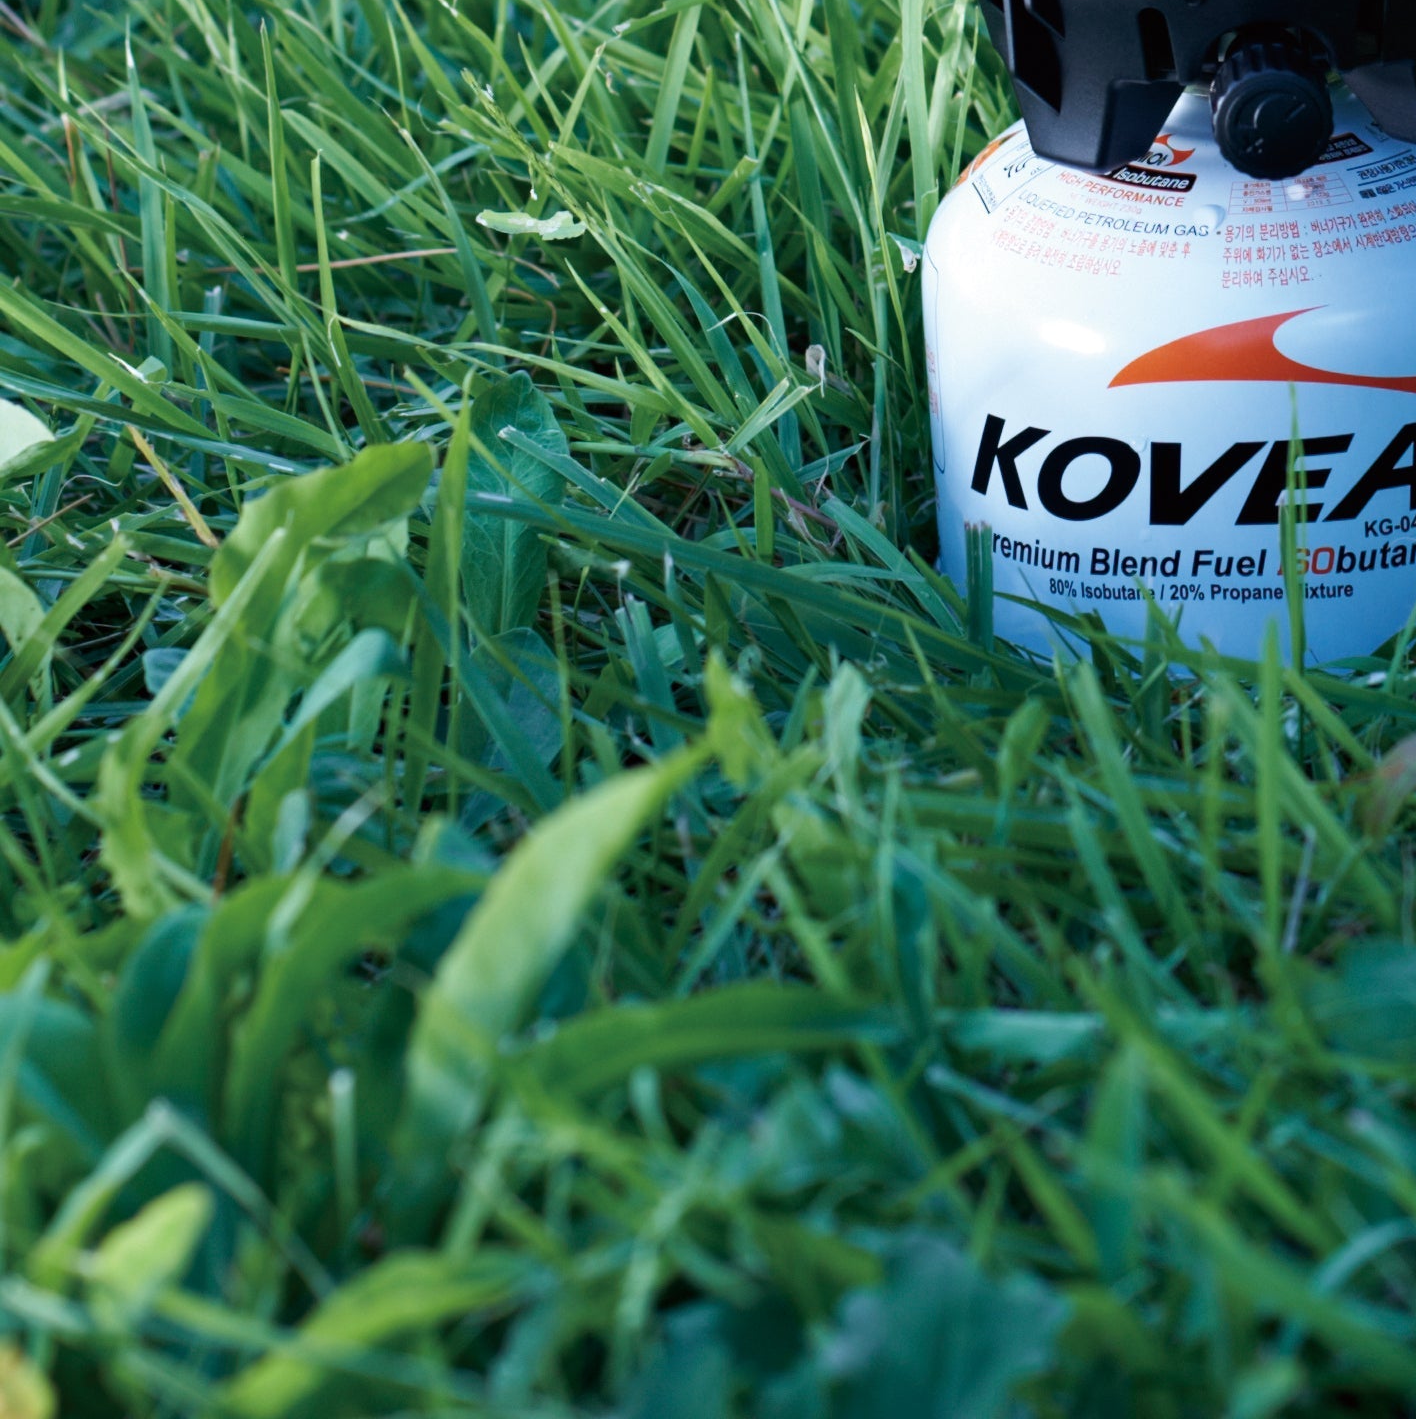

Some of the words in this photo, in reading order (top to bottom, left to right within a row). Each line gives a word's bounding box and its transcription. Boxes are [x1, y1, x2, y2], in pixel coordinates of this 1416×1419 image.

[1056, 170, 1083, 189] HIGH
[1083, 180, 1186, 208] PERFORMANCE
[1076, 210, 1169, 236] PETROLEUM
[1174, 225, 1210, 237] GAS
[1224, 223, 1255, 243] 용기의
[1259, 221, 1301, 240] 분리방법
[1310, 212, 1358, 234] 버너기구가
[1358, 206, 1387, 228] 완전히
[1222, 246, 1253, 265] 주위에
[1256, 245, 1287, 262] 화기가
[1289, 243, 1310, 260] 없는
[1312, 236, 1354, 259] 장소에서
[1221, 269, 1264, 289] 분리하여
[992, 532, 1081, 575] remium
[1090, 546, 1182, 578] Blend
[1190, 549, 1268, 578] Fuel
[1049, 577, 1077, 599] 80%
[1169, 583, 1205, 601] 20%
[1210, 583, 1284, 604] Propane
[1290, 582, 1354, 600] ixture
